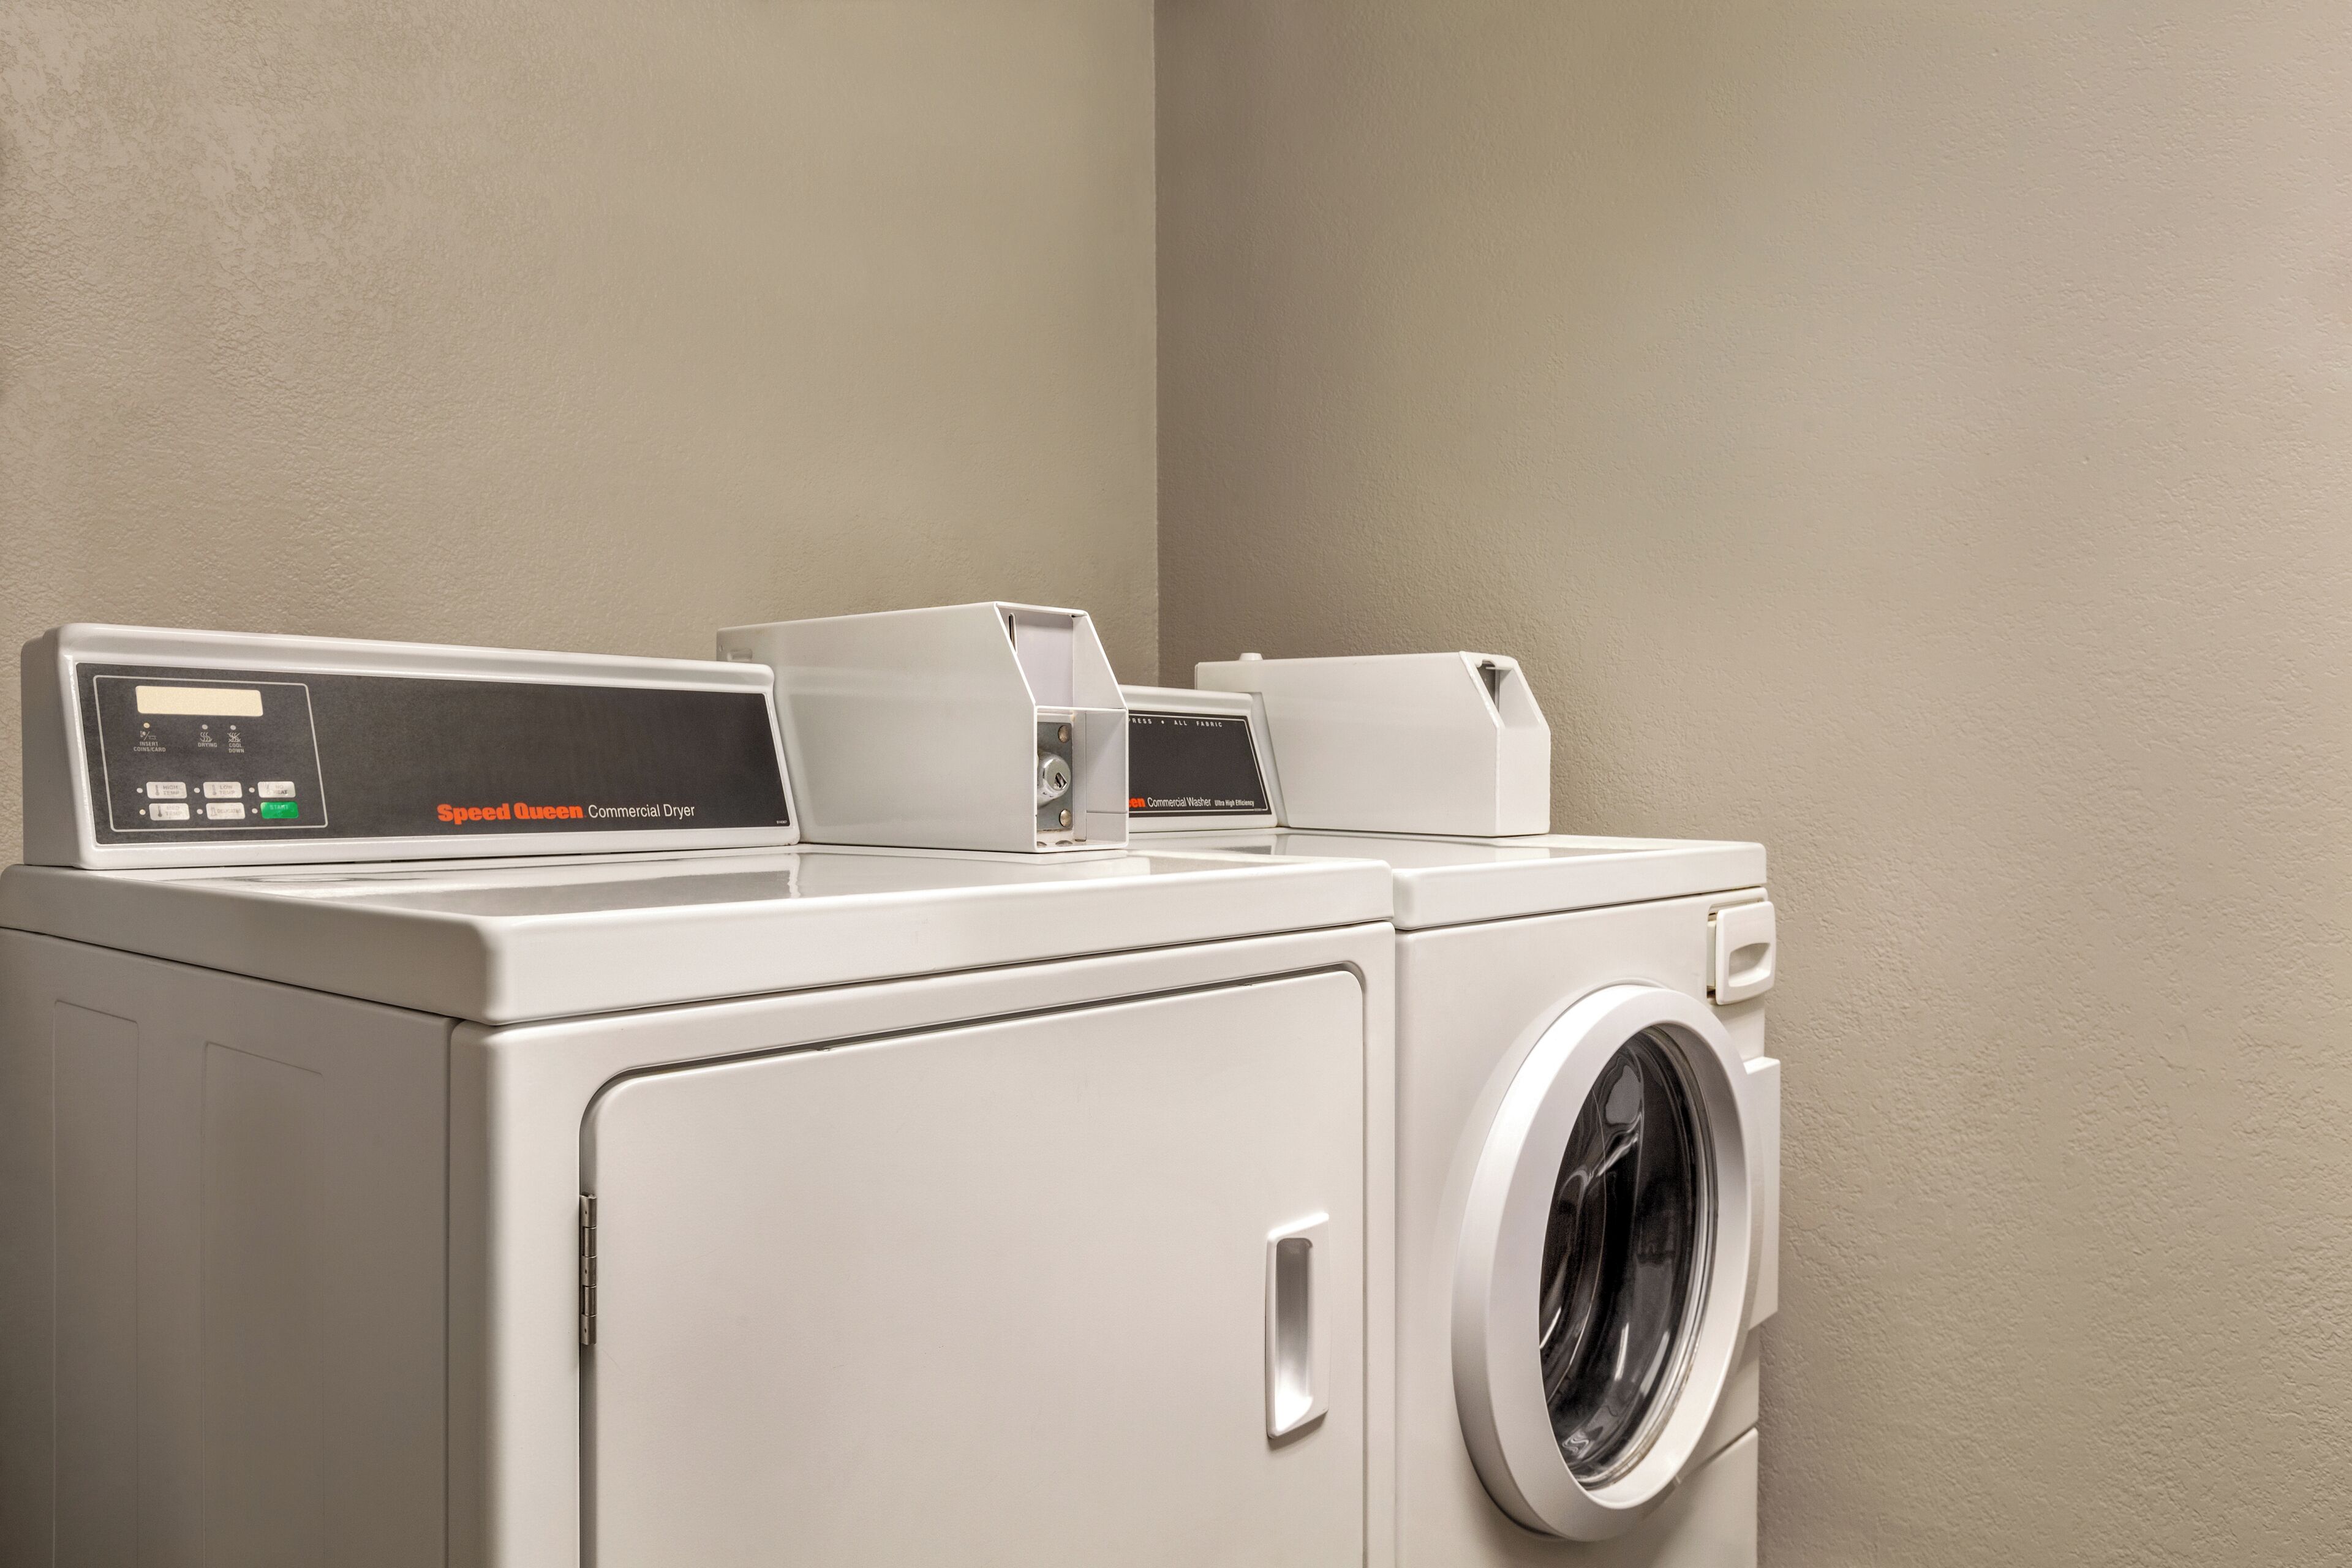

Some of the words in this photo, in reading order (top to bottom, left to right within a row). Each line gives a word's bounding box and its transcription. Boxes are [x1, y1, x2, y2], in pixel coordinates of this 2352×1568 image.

[1147, 797, 1186, 808] Commercial
[1186, 797, 1211, 807] Washer
[437, 803, 510, 825] Speed
[514, 802, 584, 820] Queen
[588, 804, 660, 819] Commercial
[665, 804, 695, 820] Dryer
